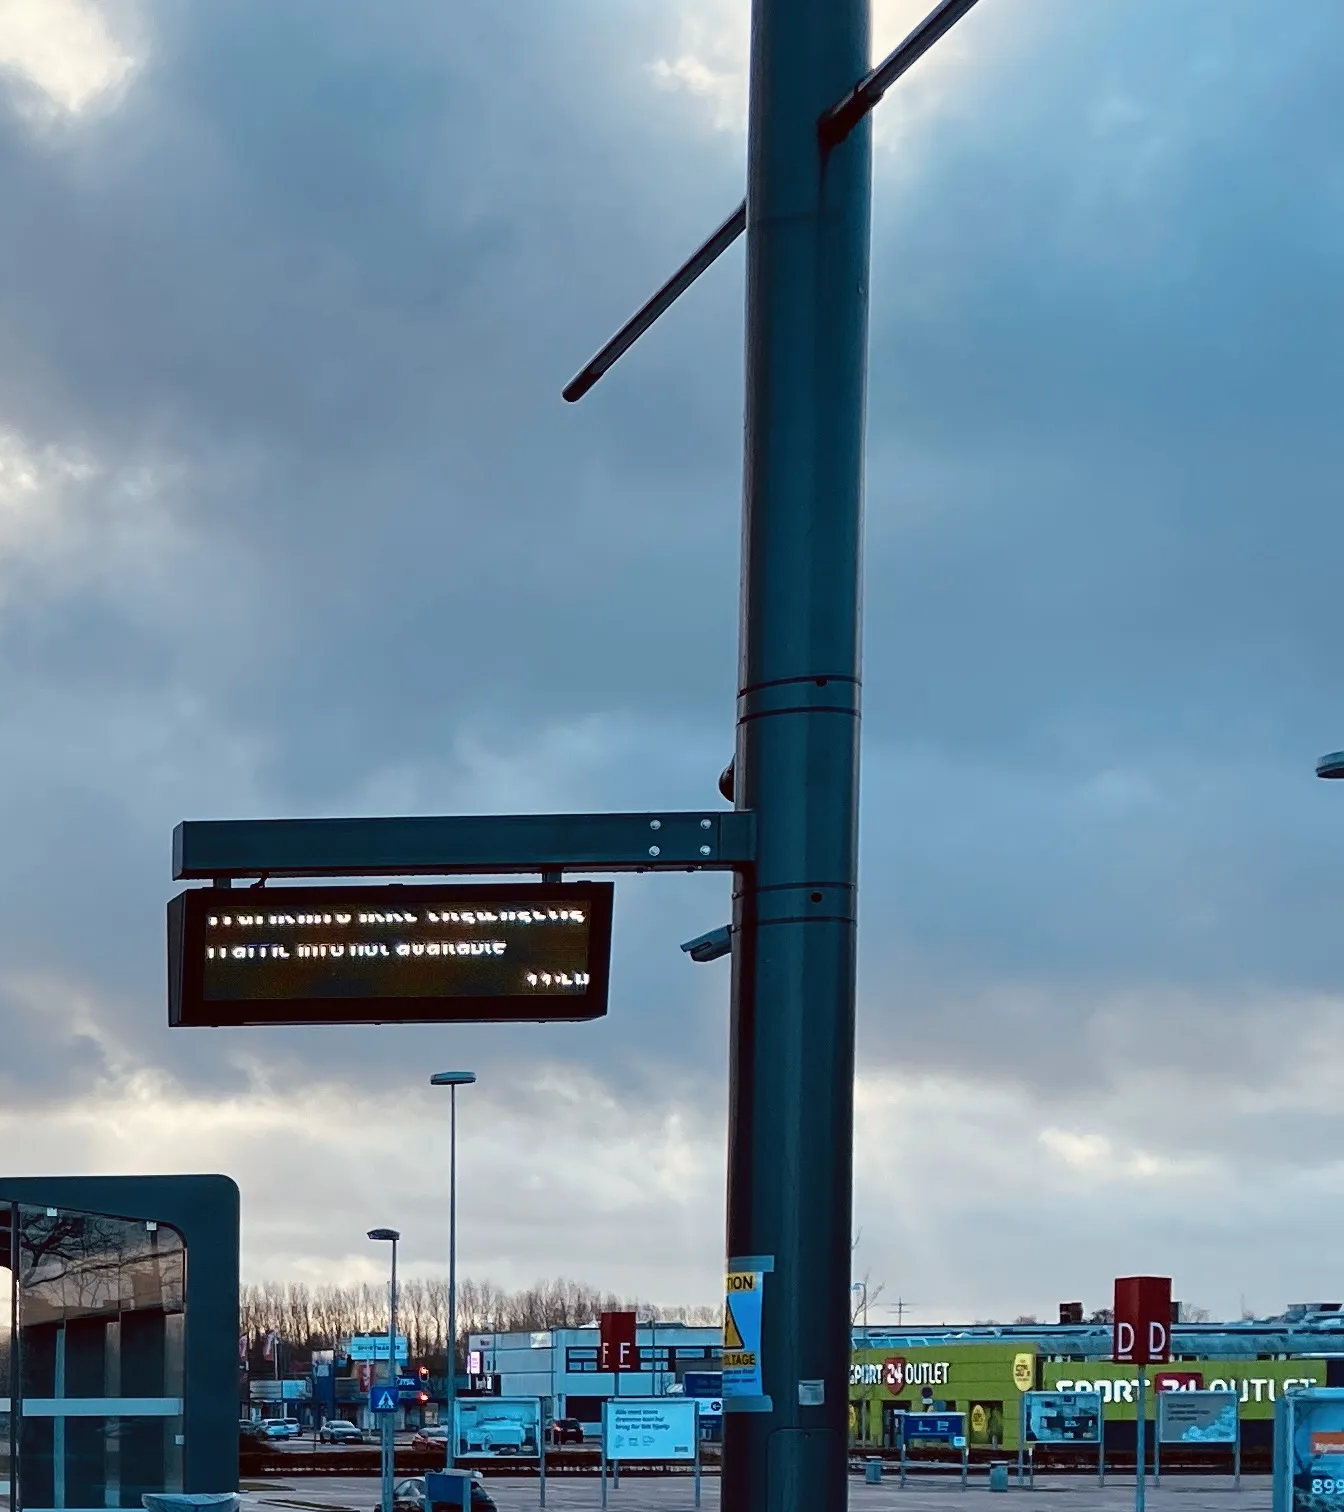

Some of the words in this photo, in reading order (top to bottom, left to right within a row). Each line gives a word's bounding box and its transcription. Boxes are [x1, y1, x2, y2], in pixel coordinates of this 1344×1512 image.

[1117, 1322, 1135, 1353] D
[1148, 1321, 1166, 1353] D
[905, 1362, 950, 1384] OUTLET
